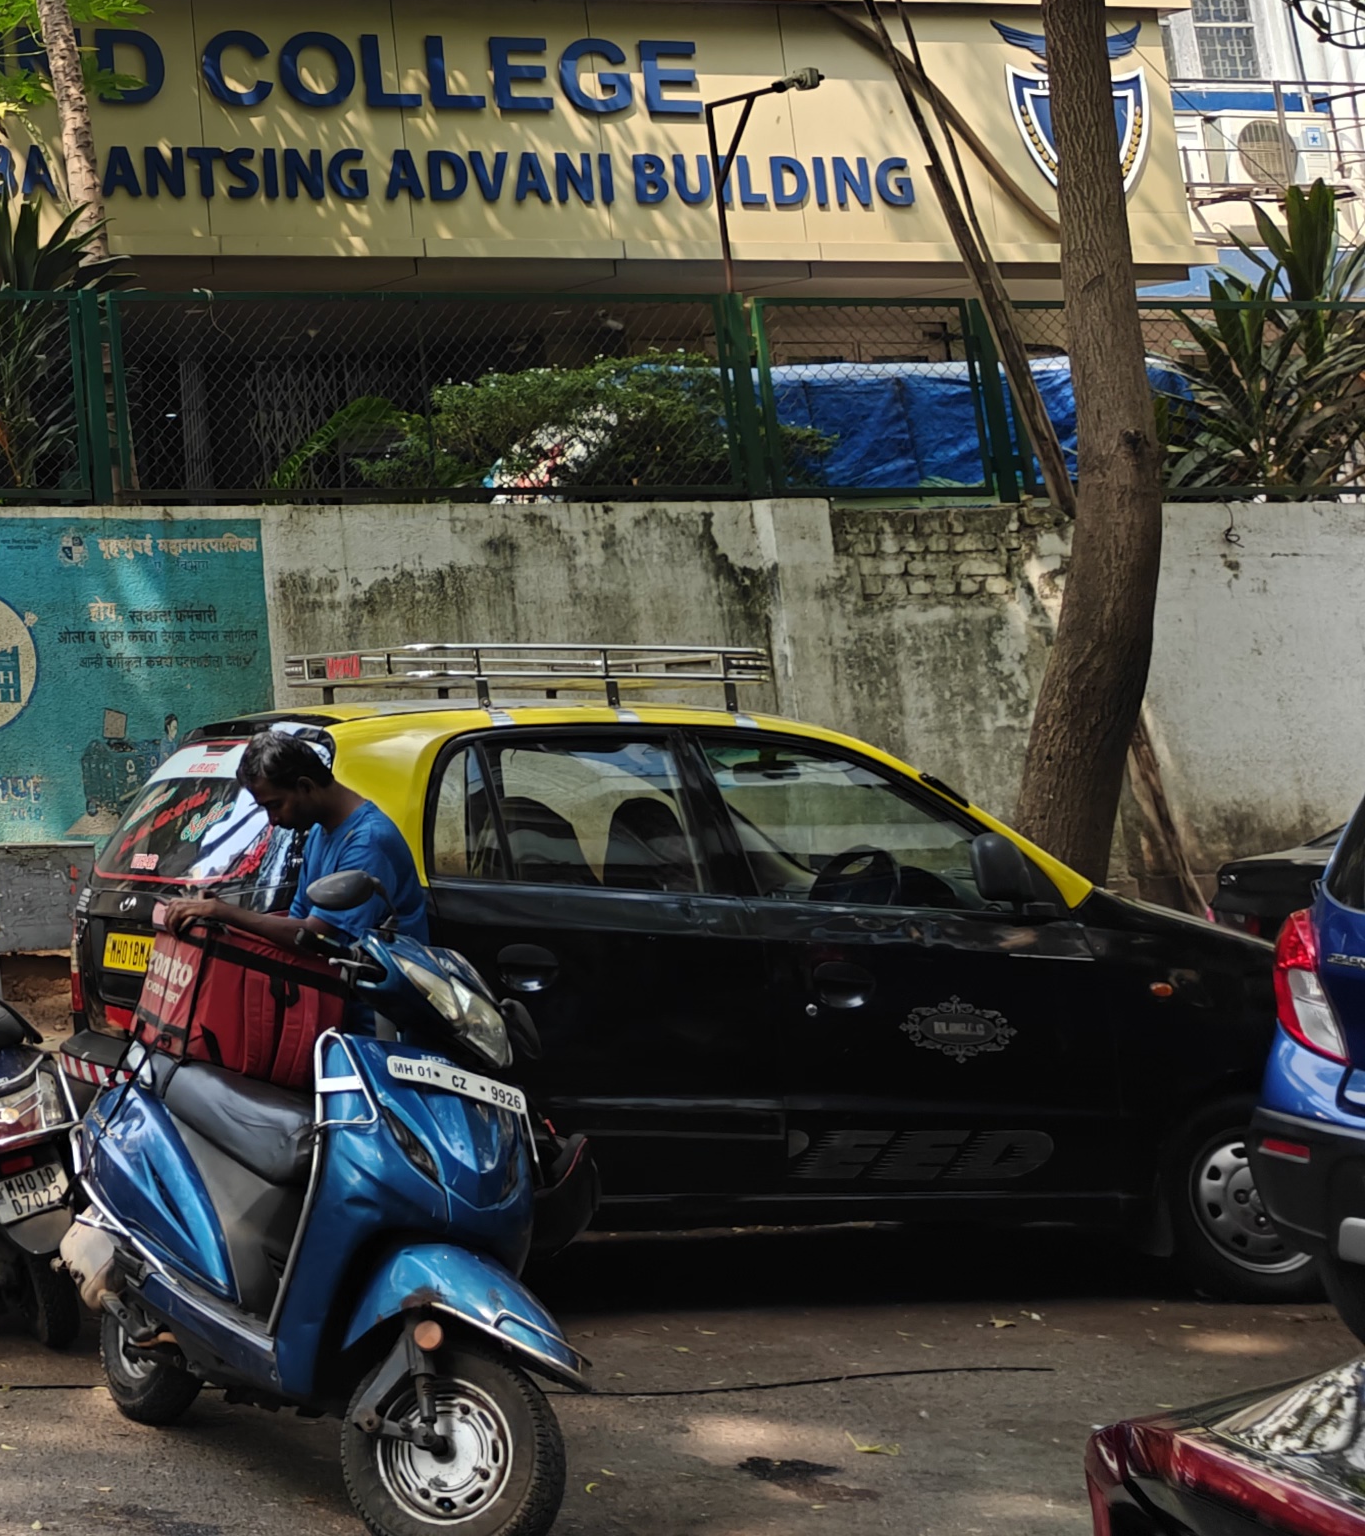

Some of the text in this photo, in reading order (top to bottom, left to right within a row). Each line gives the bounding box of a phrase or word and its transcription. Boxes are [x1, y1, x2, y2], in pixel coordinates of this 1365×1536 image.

[202, 30, 704, 114] COLLEGE
[386, 149, 615, 205] ADVANI
[632, 154, 916, 208] BUILDING
[393, 1062, 522, 1110] MH 01 CZ 9926
[4, 1166, 57, 1199] MH01D
